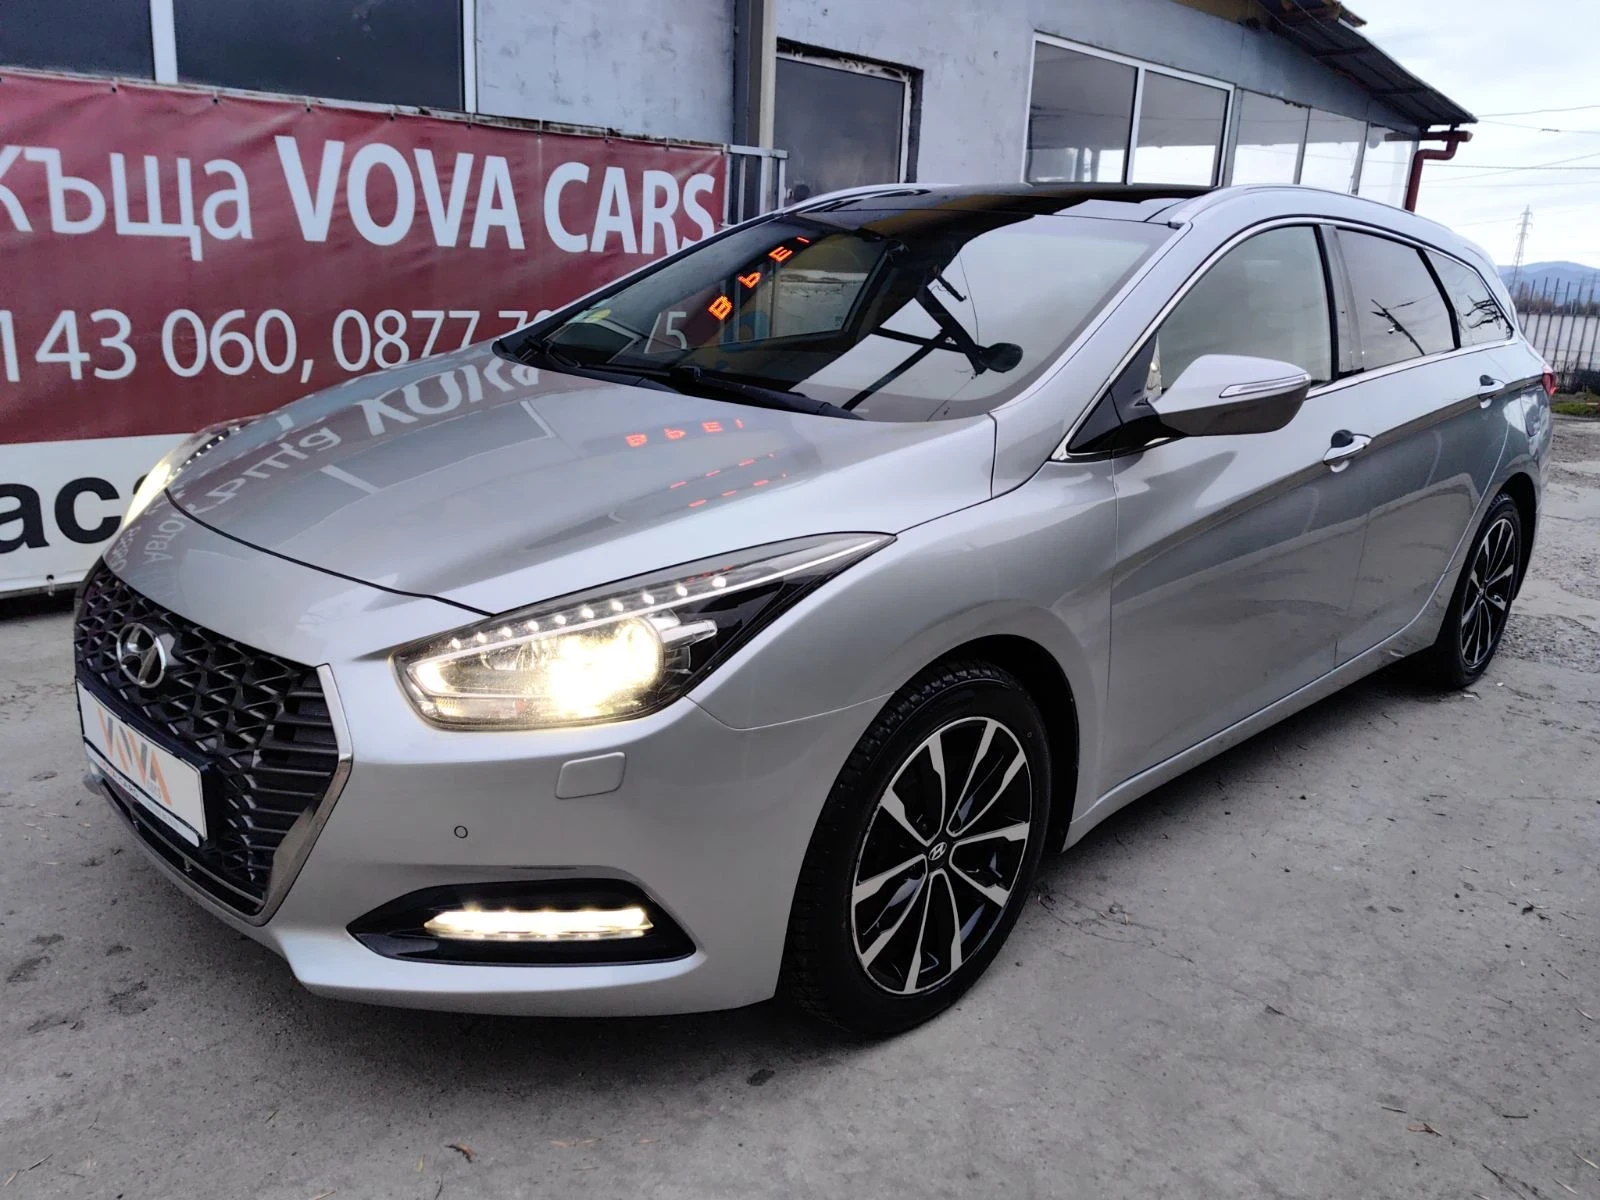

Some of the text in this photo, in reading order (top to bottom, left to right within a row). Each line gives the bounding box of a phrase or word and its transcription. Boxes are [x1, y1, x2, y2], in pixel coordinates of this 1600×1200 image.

[275, 136, 526, 250] VOVA
[543, 161, 716, 254] CARS
[161, 308, 314, 383] 060,
[332, 309, 480, 372] 0877
